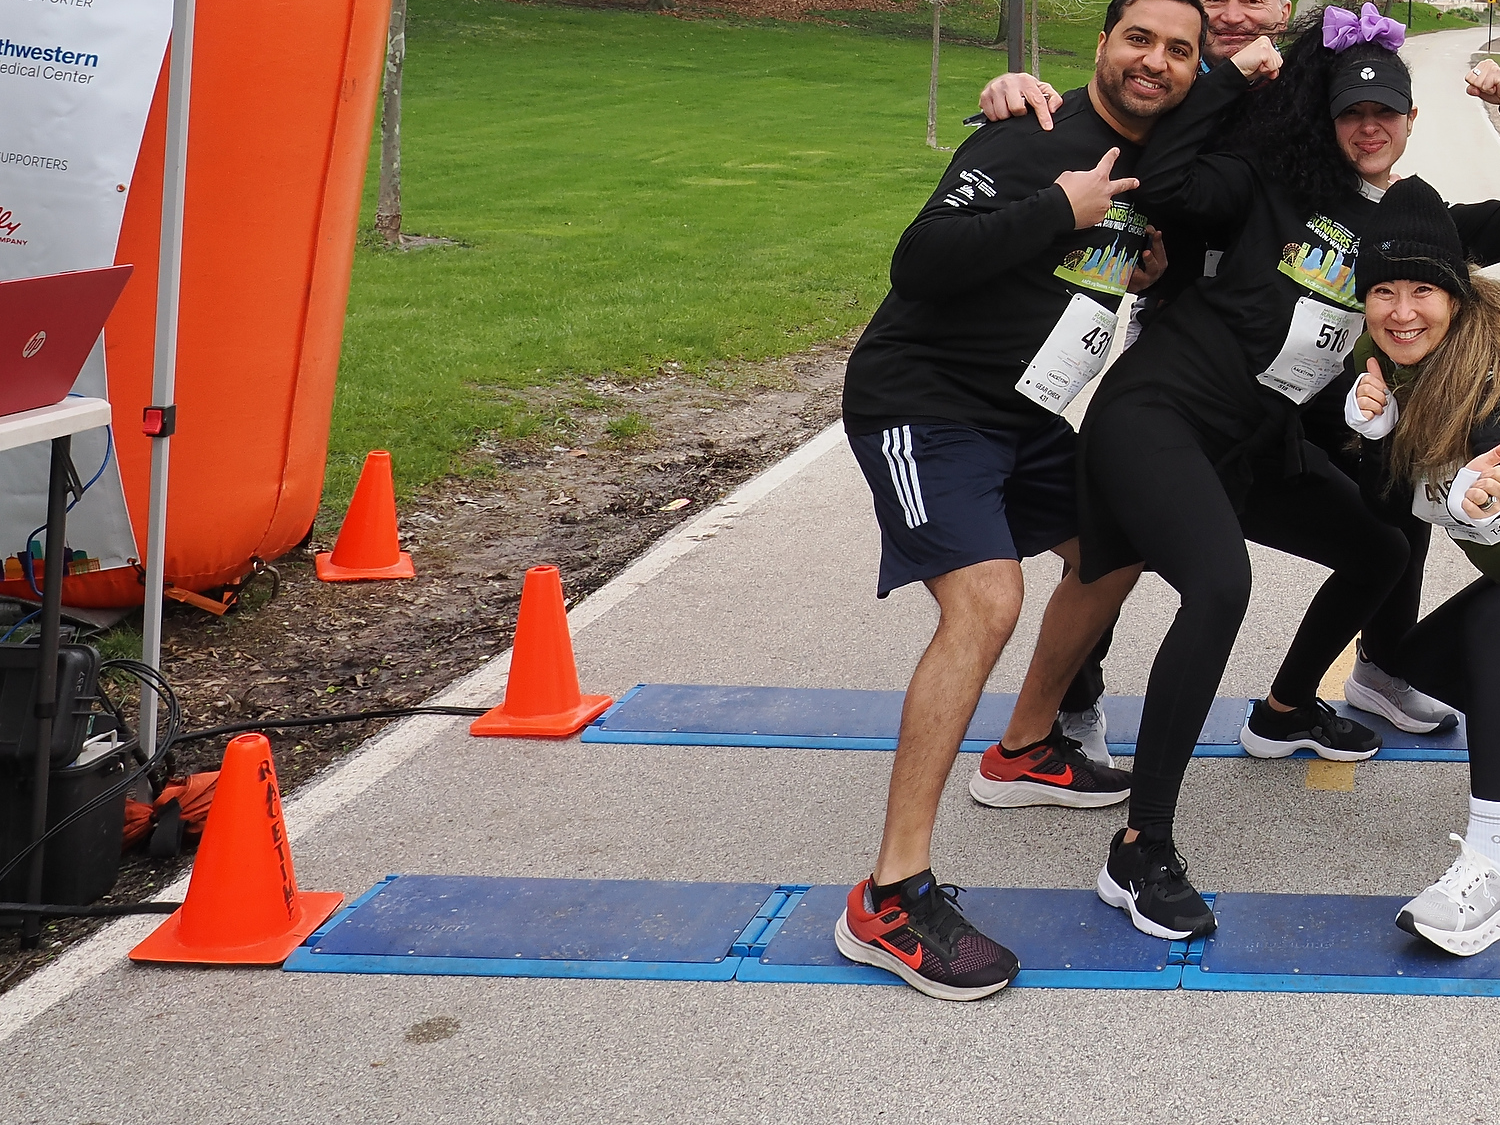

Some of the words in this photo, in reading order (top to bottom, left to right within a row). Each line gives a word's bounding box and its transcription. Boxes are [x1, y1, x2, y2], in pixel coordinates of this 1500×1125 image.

[0, 61, 41, 78] edical
[43, 65, 94, 84] Center
[0, 151, 69, 171] UPPORTERS
[24, 332, 46, 357] hp
[1081, 326, 1112, 358] 431
[1315, 323, 1349, 353] 518
[1035, 382, 1049, 394] GEAR
[1047, 389, 1061, 400] CHECK
[1039, 394, 1049, 403] 431
[258, 759, 294, 921] RACETIME
